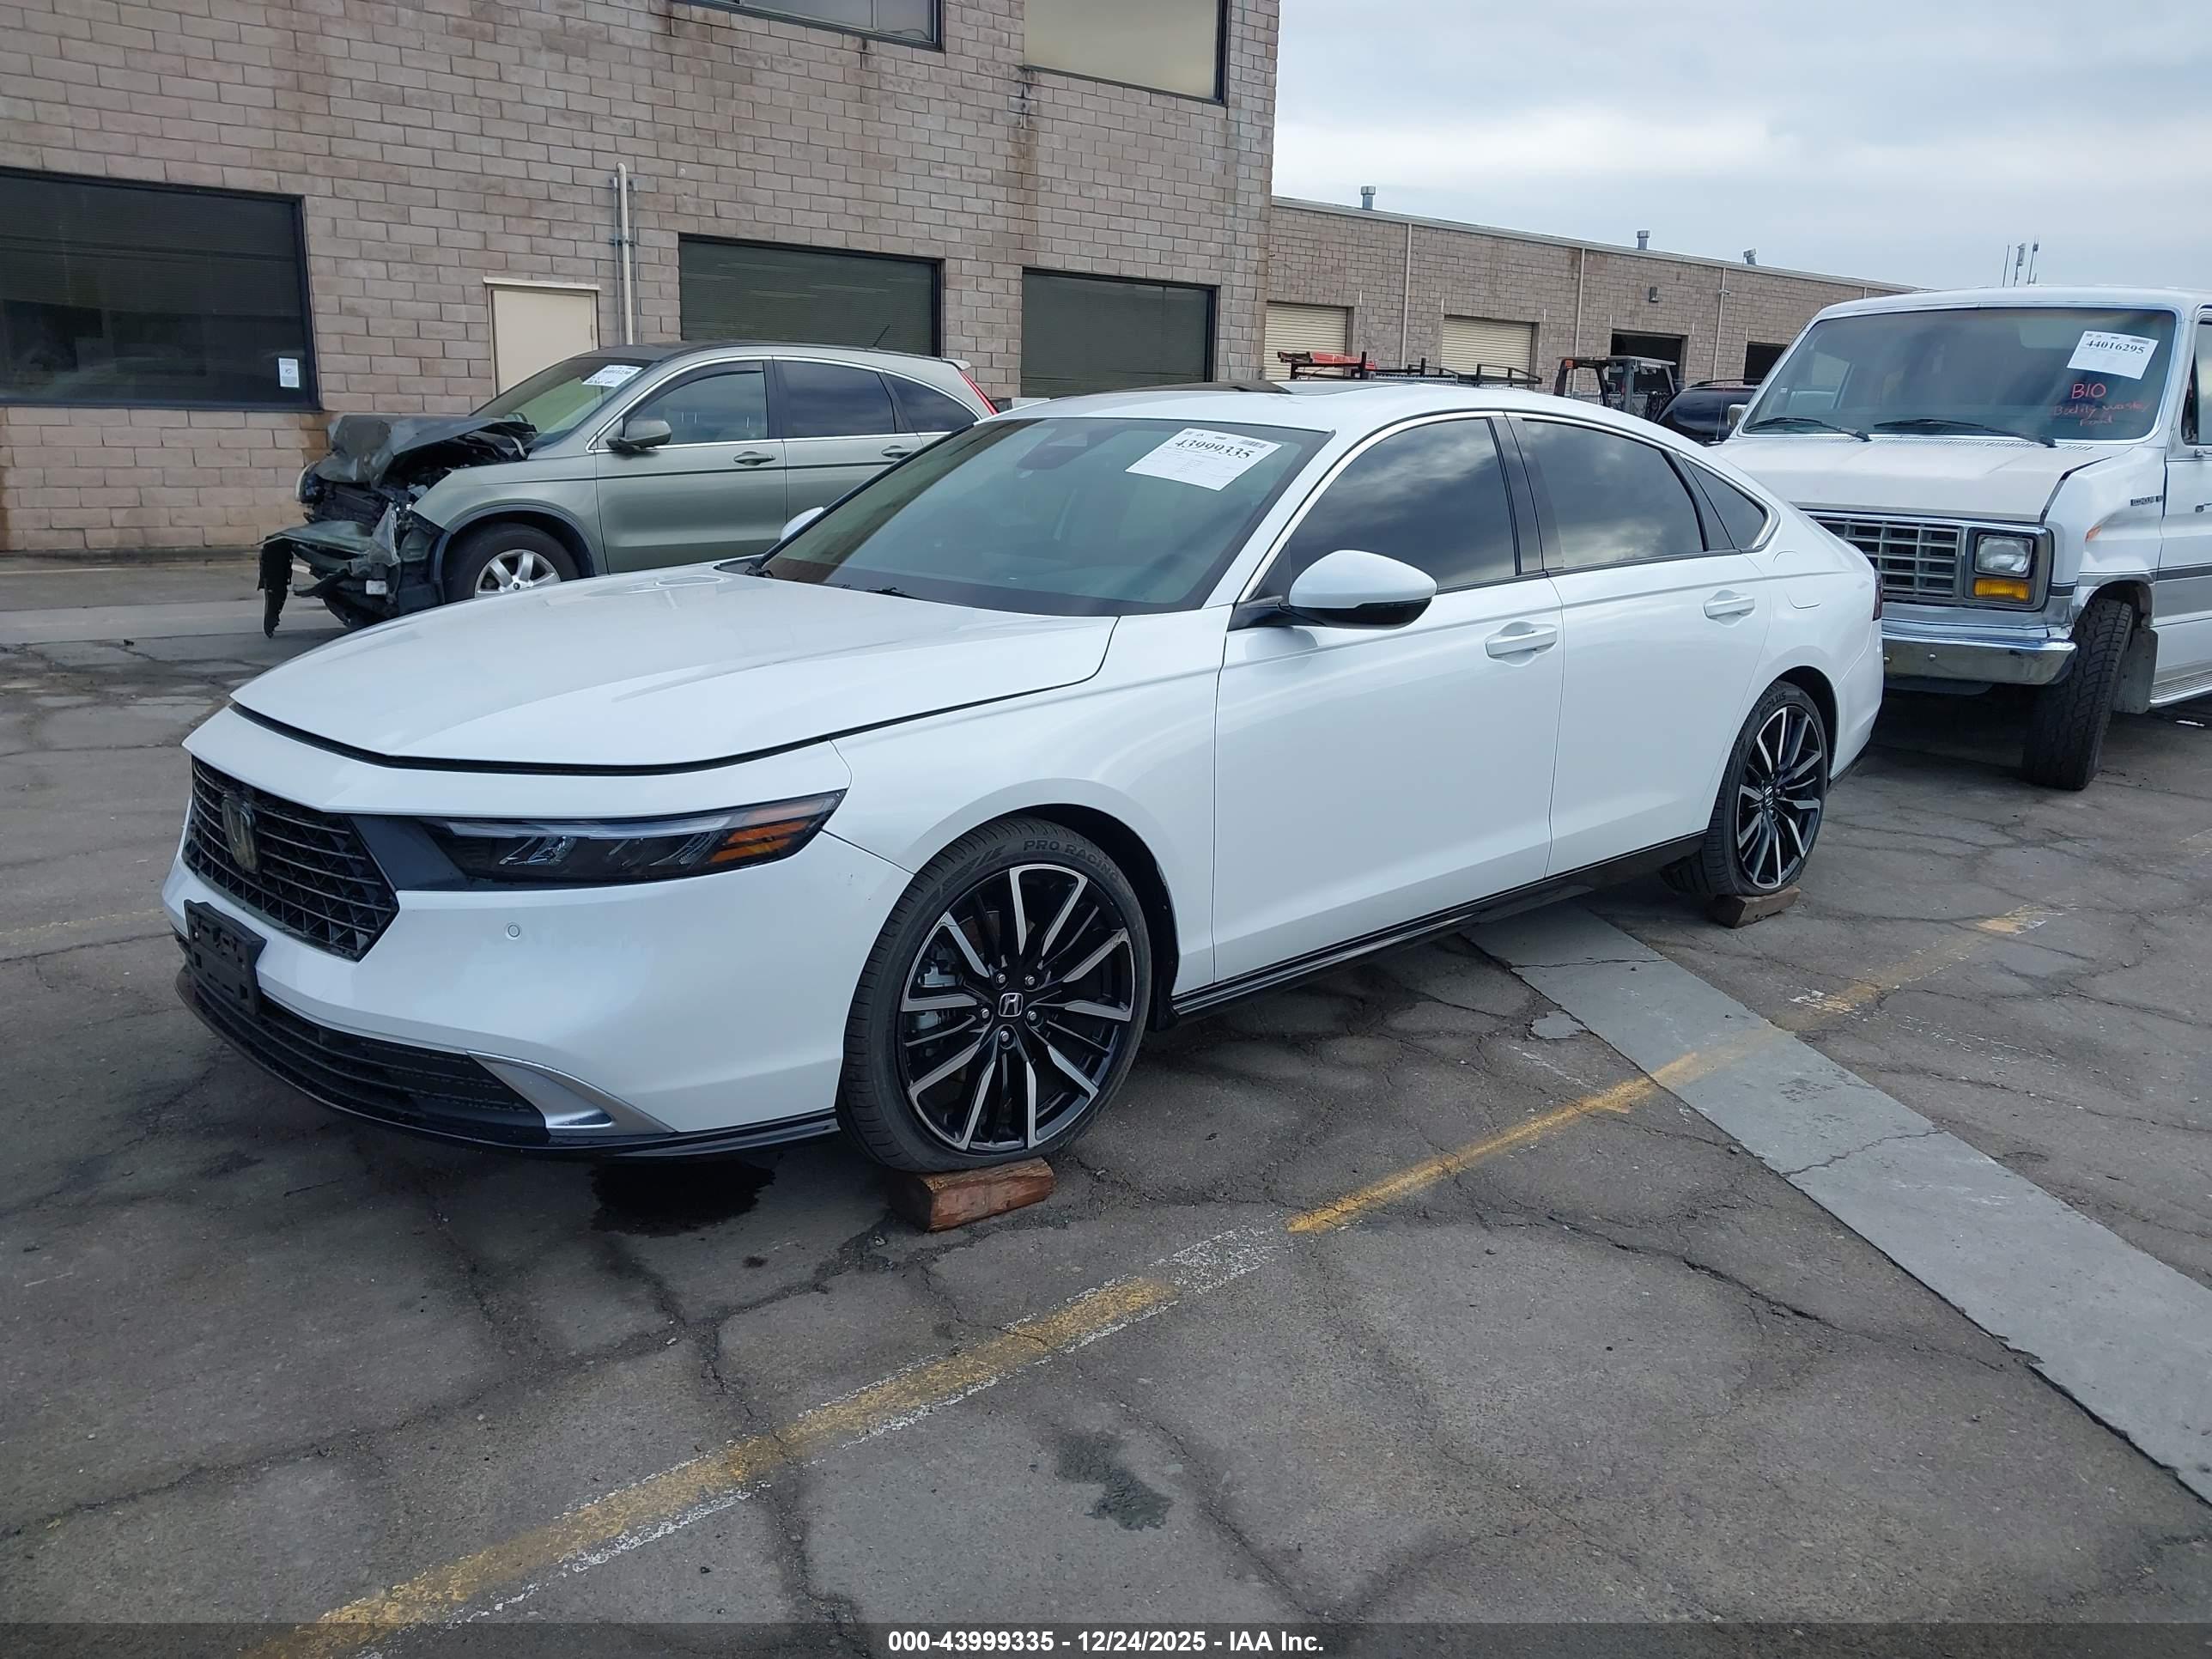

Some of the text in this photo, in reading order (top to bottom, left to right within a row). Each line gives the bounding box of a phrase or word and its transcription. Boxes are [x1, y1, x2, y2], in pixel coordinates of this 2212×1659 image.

[2086, 339, 2145, 355] 44016295
[2071, 383, 2106, 399] BIO
[1175, 438, 1255, 459] 43999335
[1024, 840, 1060, 852] PRO
